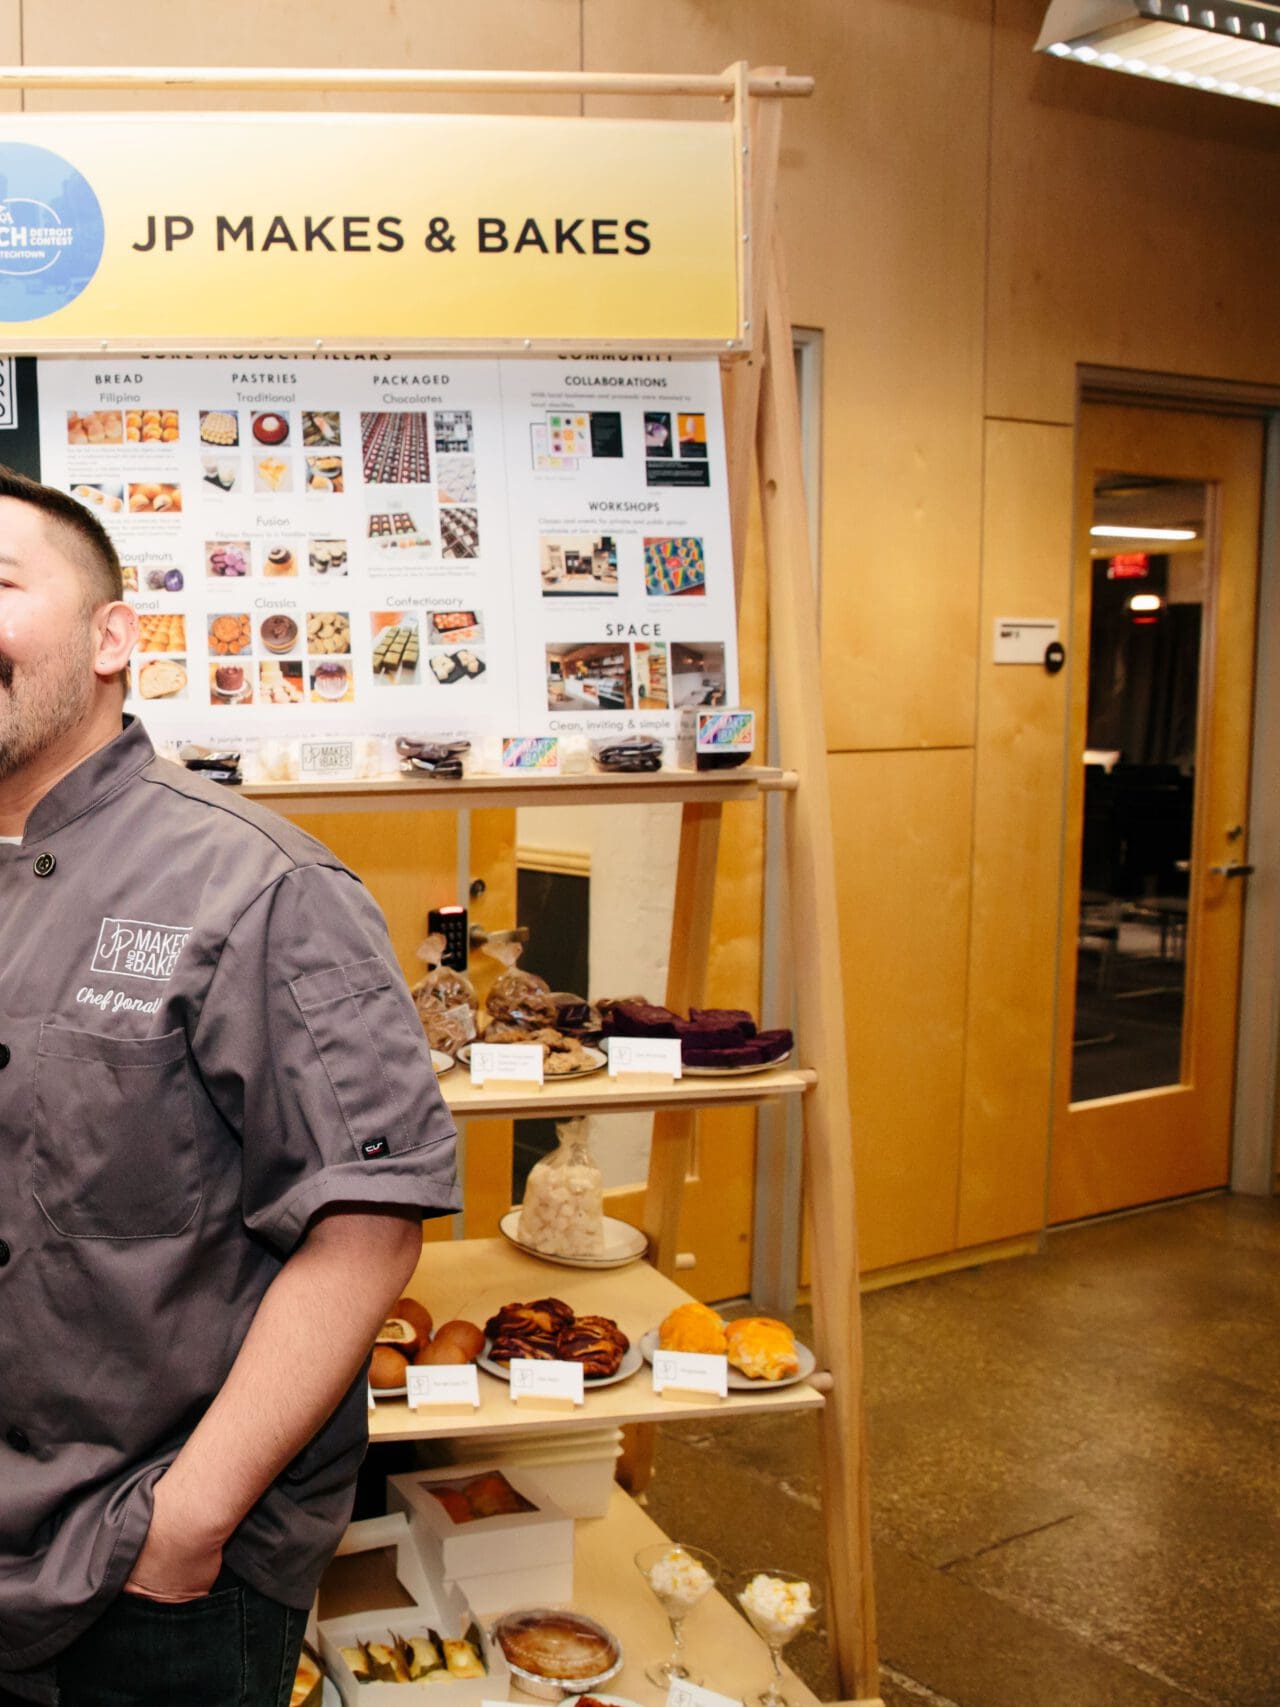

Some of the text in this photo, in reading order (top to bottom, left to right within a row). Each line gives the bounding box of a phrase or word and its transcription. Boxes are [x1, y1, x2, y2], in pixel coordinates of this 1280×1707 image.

[30, 228, 73, 237] DETROIT
[131, 215, 652, 256] JP MAKES & BAKES
[30, 237, 73, 246] CONTEST
[0, 251, 46, 259] TECHTOWN
[94, 374, 144, 385] BREAD
[231, 373, 298, 384] PASTRIES
[372, 375, 451, 385] PACKAGED
[565, 376, 668, 388] COLLABORATIONS
[99, 393, 141, 404] Filipino
[236, 392, 296, 403] Traditional
[382, 393, 443, 404] Chocolates
[588, 501, 661, 512] WORKSHOPS
[256, 515, 290, 526] Fusion
[254, 598, 297, 609] Classics
[386, 596, 464, 608] Confectionary
[605, 623, 662, 636] SPACE
[548, 719, 583, 732] Clean,
[586, 719, 624, 731] inviting
[628, 719, 635, 728] &
[639, 719, 670, 730] simple
[100, 922, 135, 971] JP
[76, 987, 114, 1012] Chef
